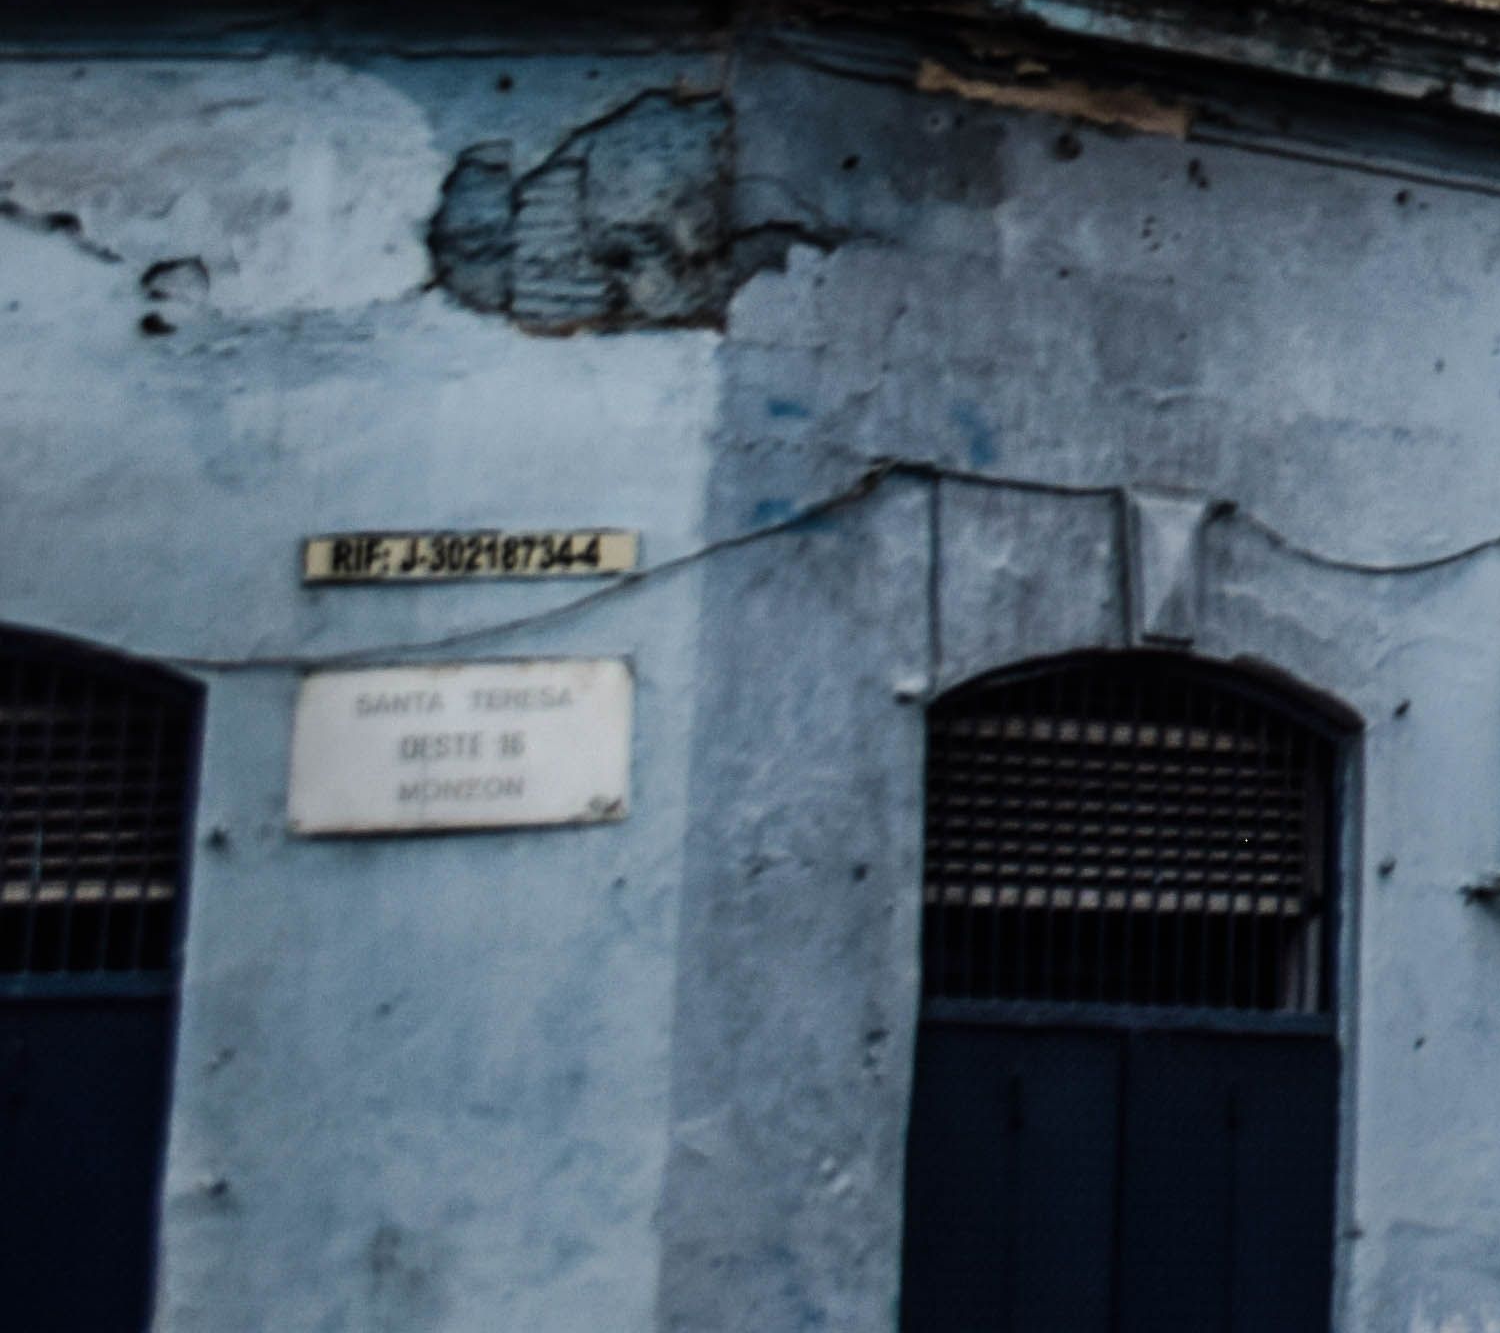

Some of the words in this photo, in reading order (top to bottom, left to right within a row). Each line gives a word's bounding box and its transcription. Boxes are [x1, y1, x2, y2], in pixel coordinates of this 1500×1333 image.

[332, 537, 390, 572] RIF:
[401, 535, 599, 572] J-30218734-4
[355, 690, 445, 717] SANTA
[470, 687, 574, 713] TERESA
[401, 732, 484, 760] OESTE
